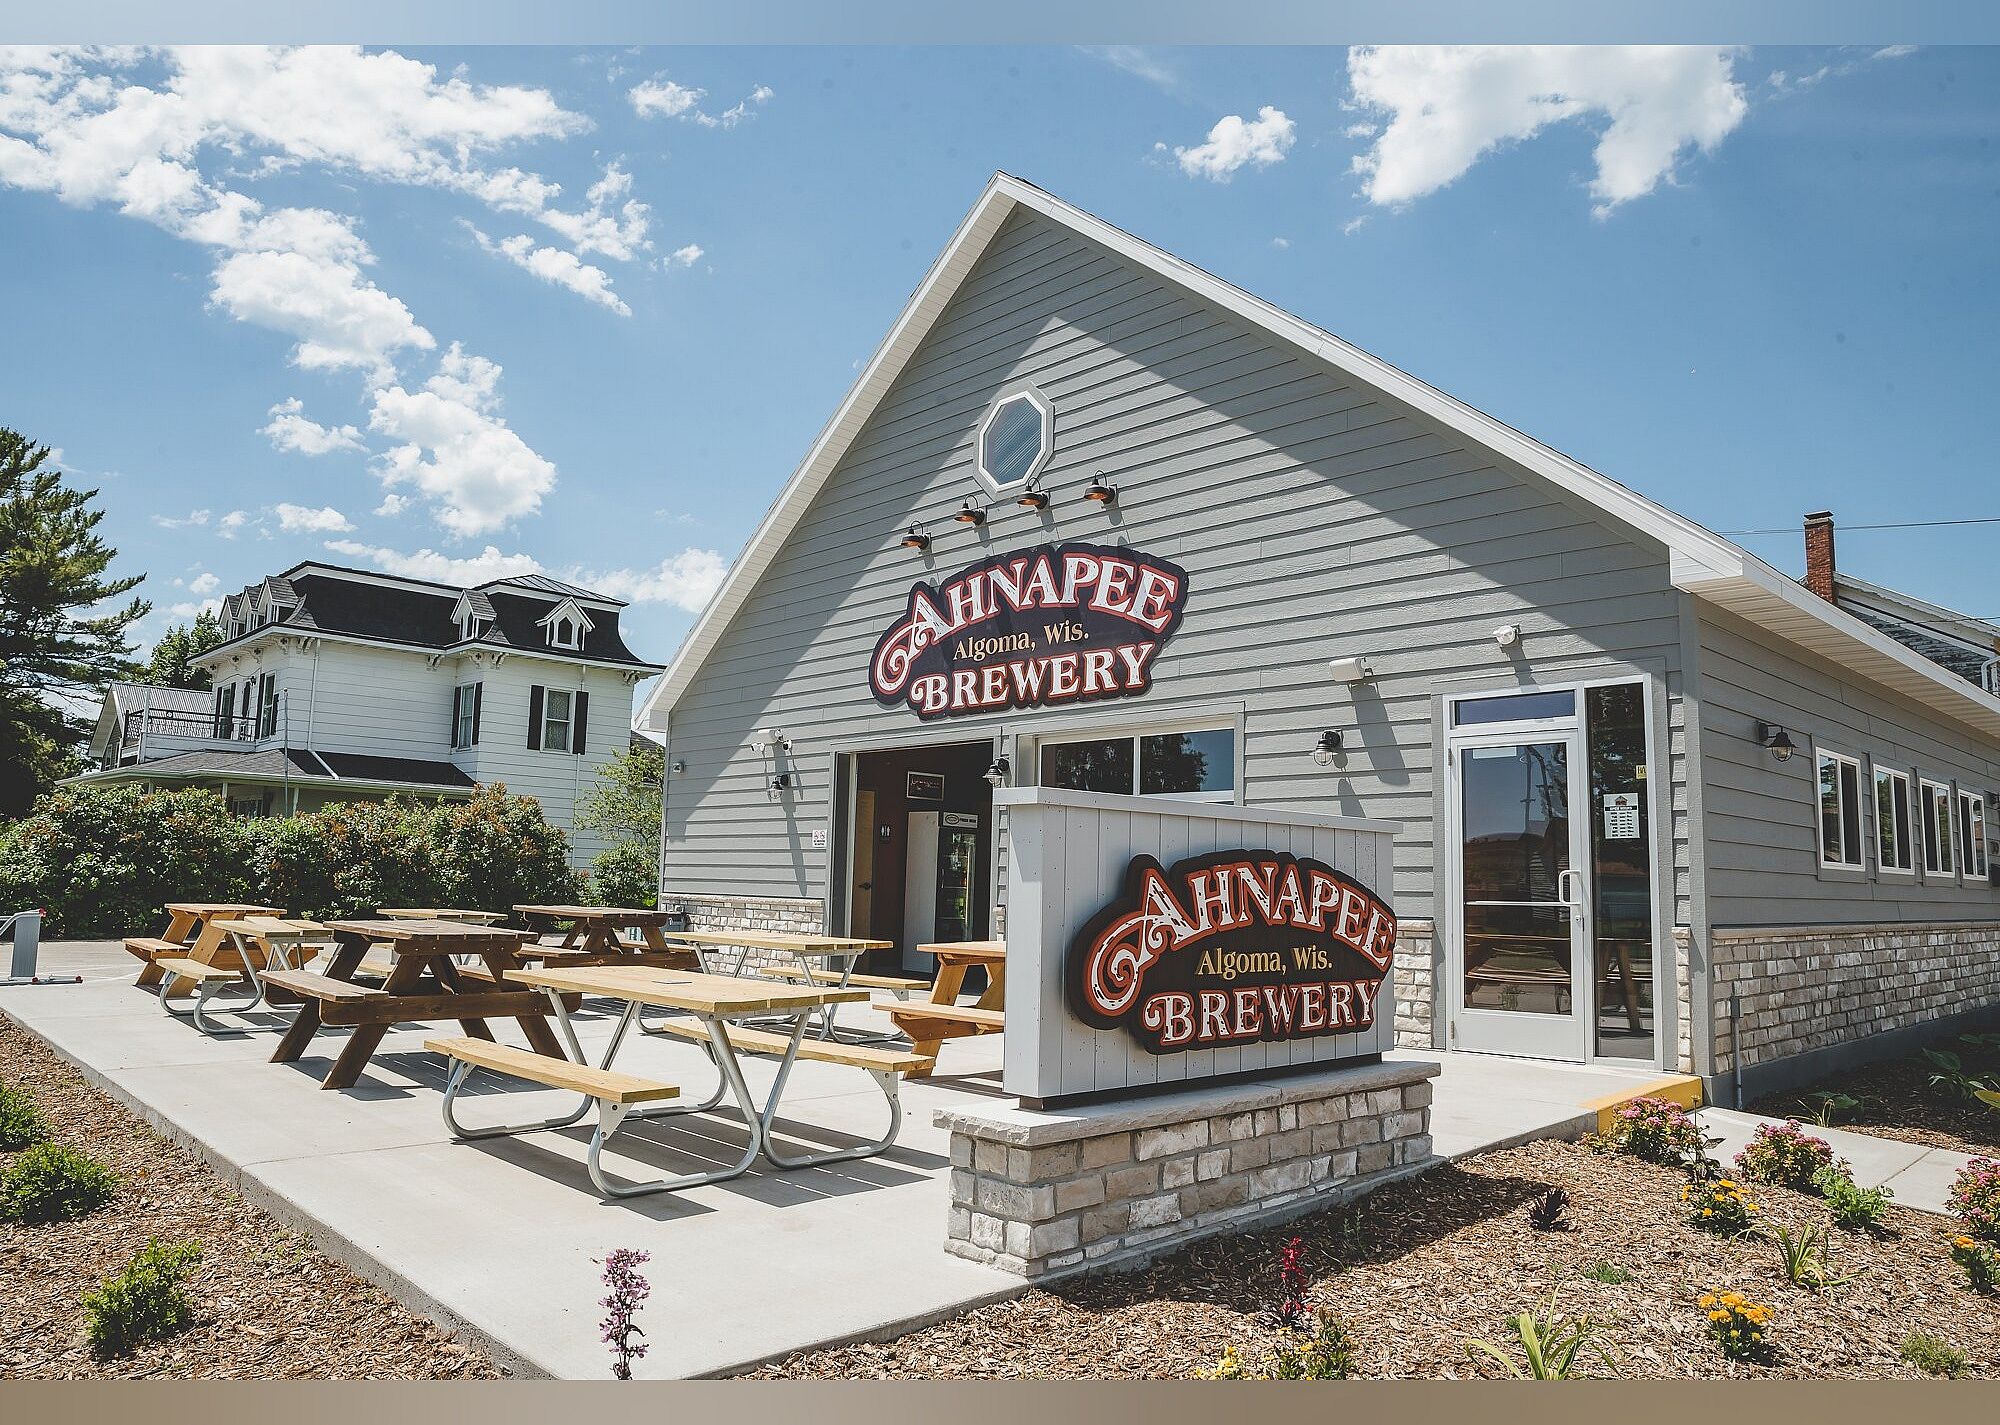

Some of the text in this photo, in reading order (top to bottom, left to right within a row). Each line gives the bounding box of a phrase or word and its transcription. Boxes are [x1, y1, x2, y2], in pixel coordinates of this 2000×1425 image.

[878, 555, 1178, 692] AHNAPEE
[953, 619, 1089, 662] Algoma, Wis.
[911, 643, 1154, 712] BREWERY
[1088, 864, 1395, 1014] AHNAPEE
[1197, 945, 1332, 979] Algoma, Wis.
[1146, 982, 1381, 1043] BREWERY
